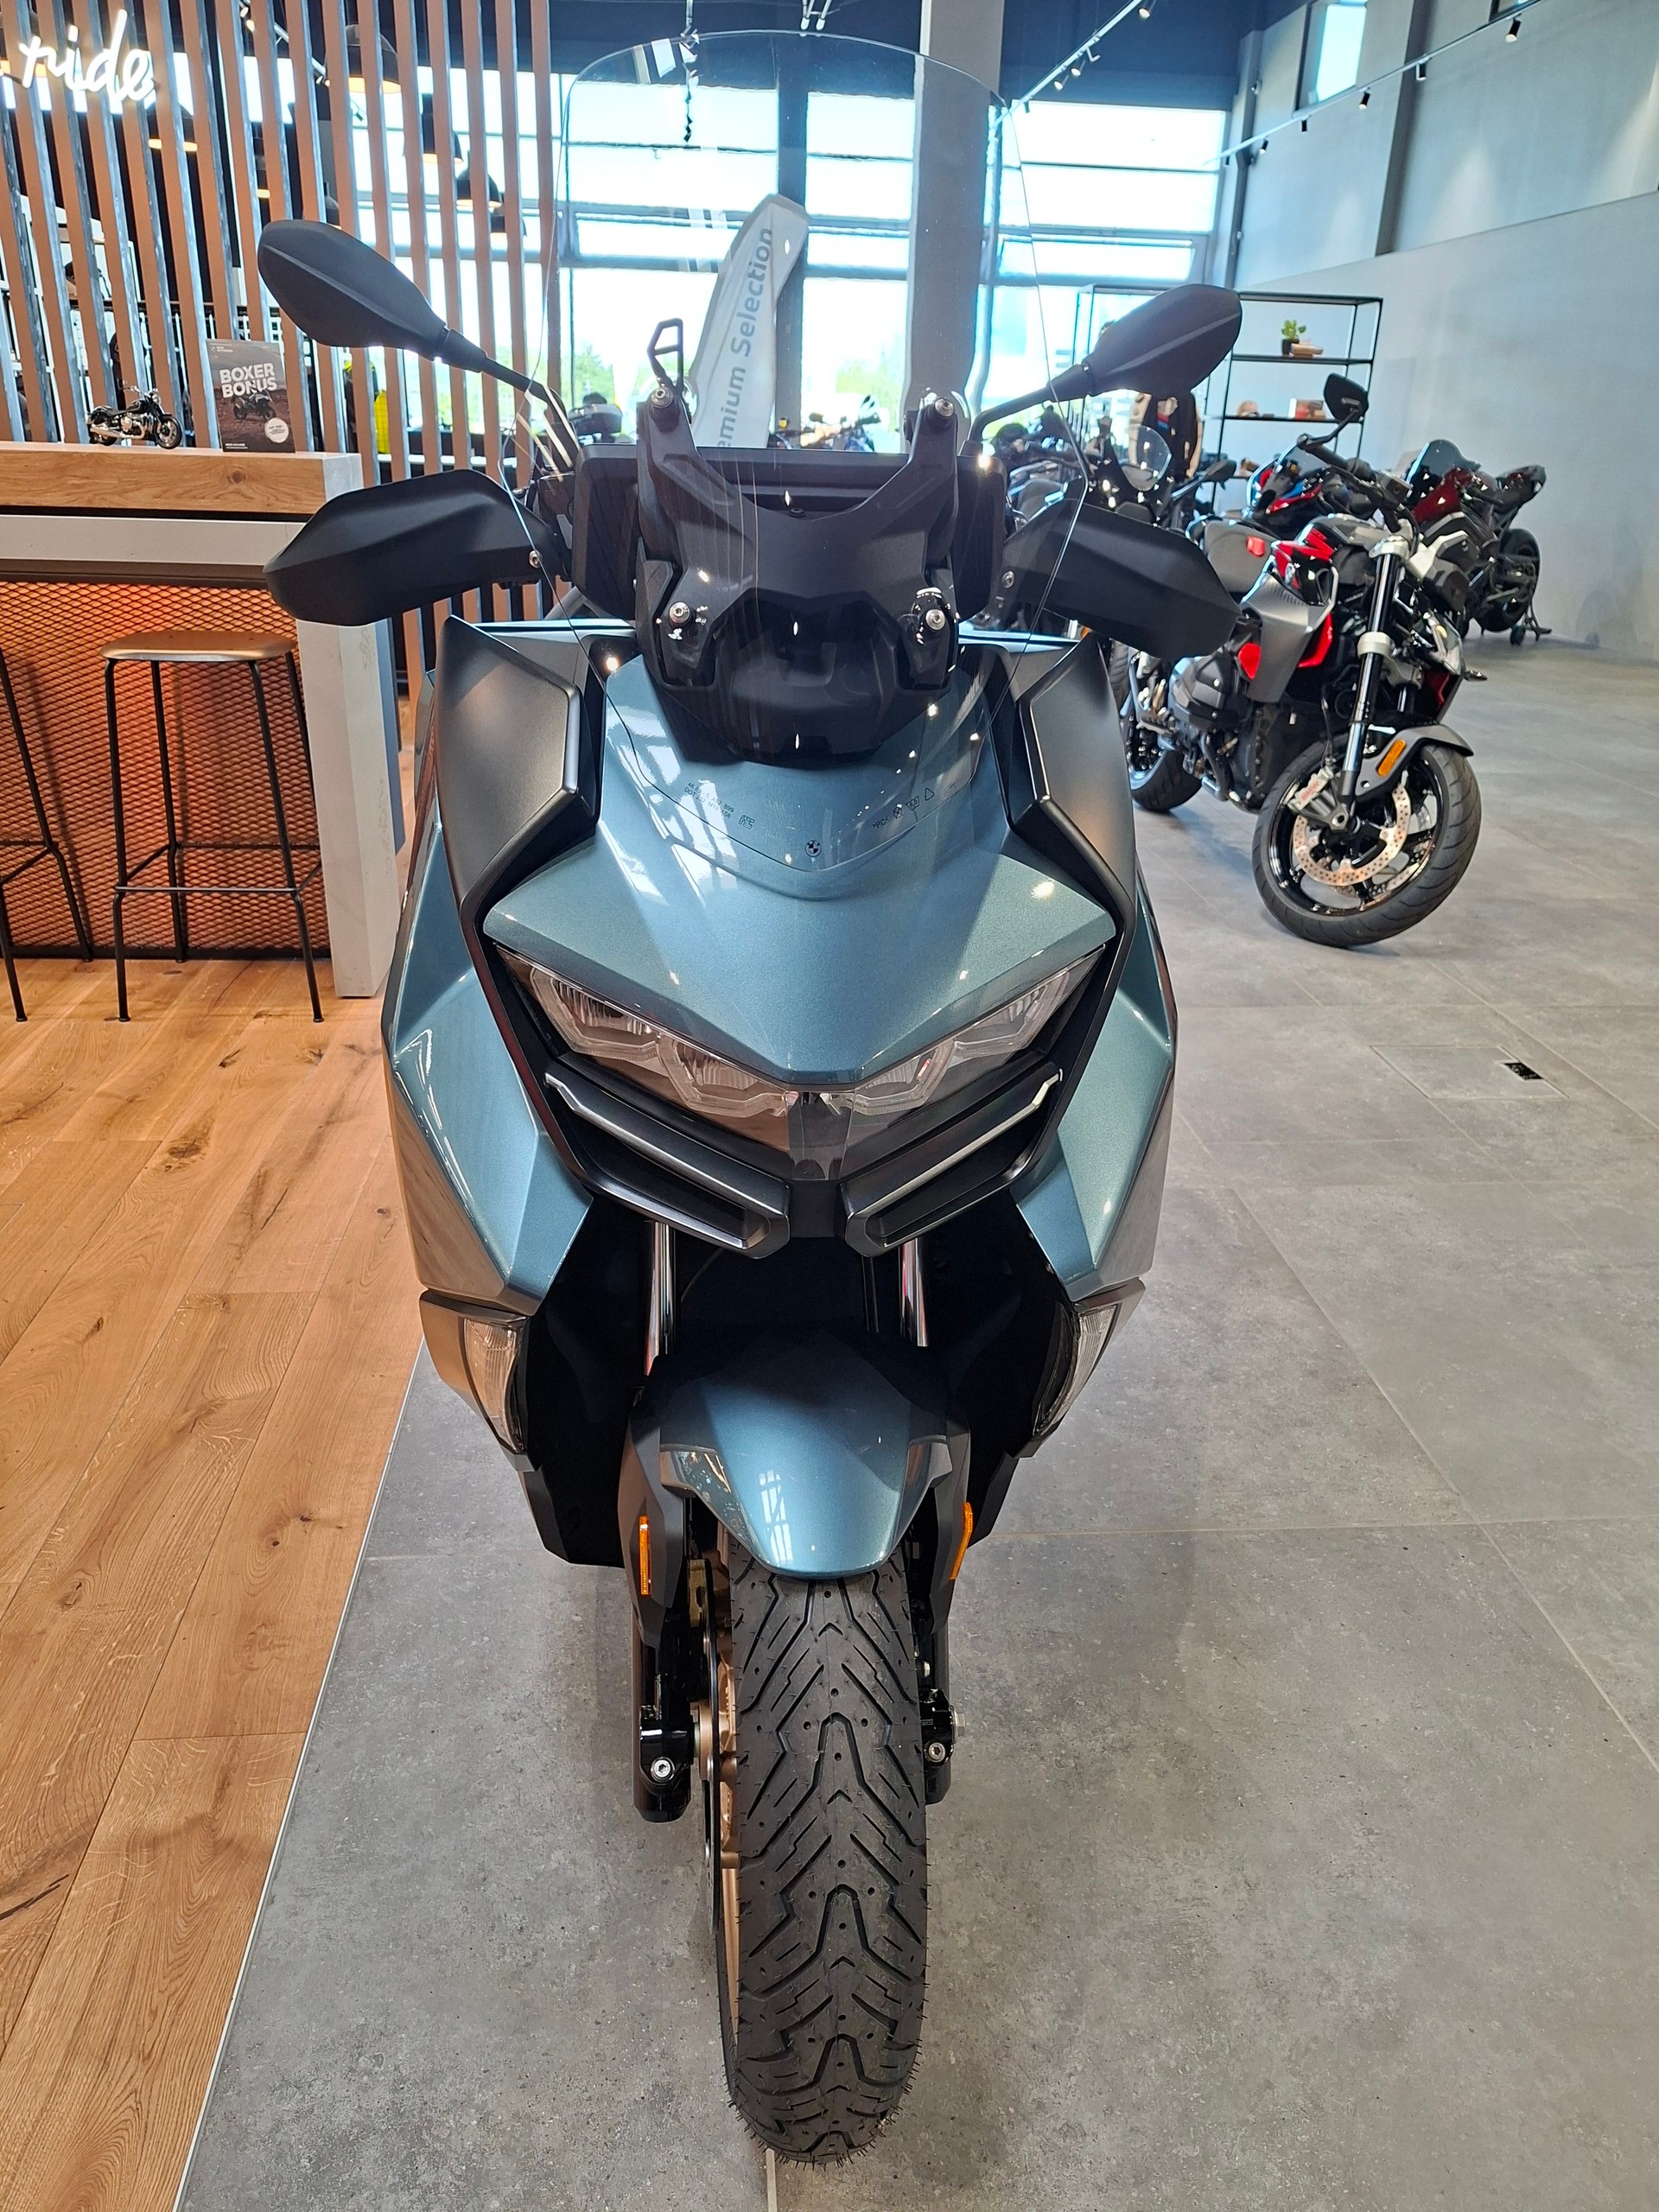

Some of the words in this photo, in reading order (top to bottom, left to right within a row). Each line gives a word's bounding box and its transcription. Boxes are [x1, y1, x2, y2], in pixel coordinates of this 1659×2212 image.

[19, 9, 155, 102] ride
[730, 227, 772, 358] Selection
[219, 363, 276, 384] BOXER
[221, 377, 277, 397] BONUS
[684, 786, 696, 797] DOT
